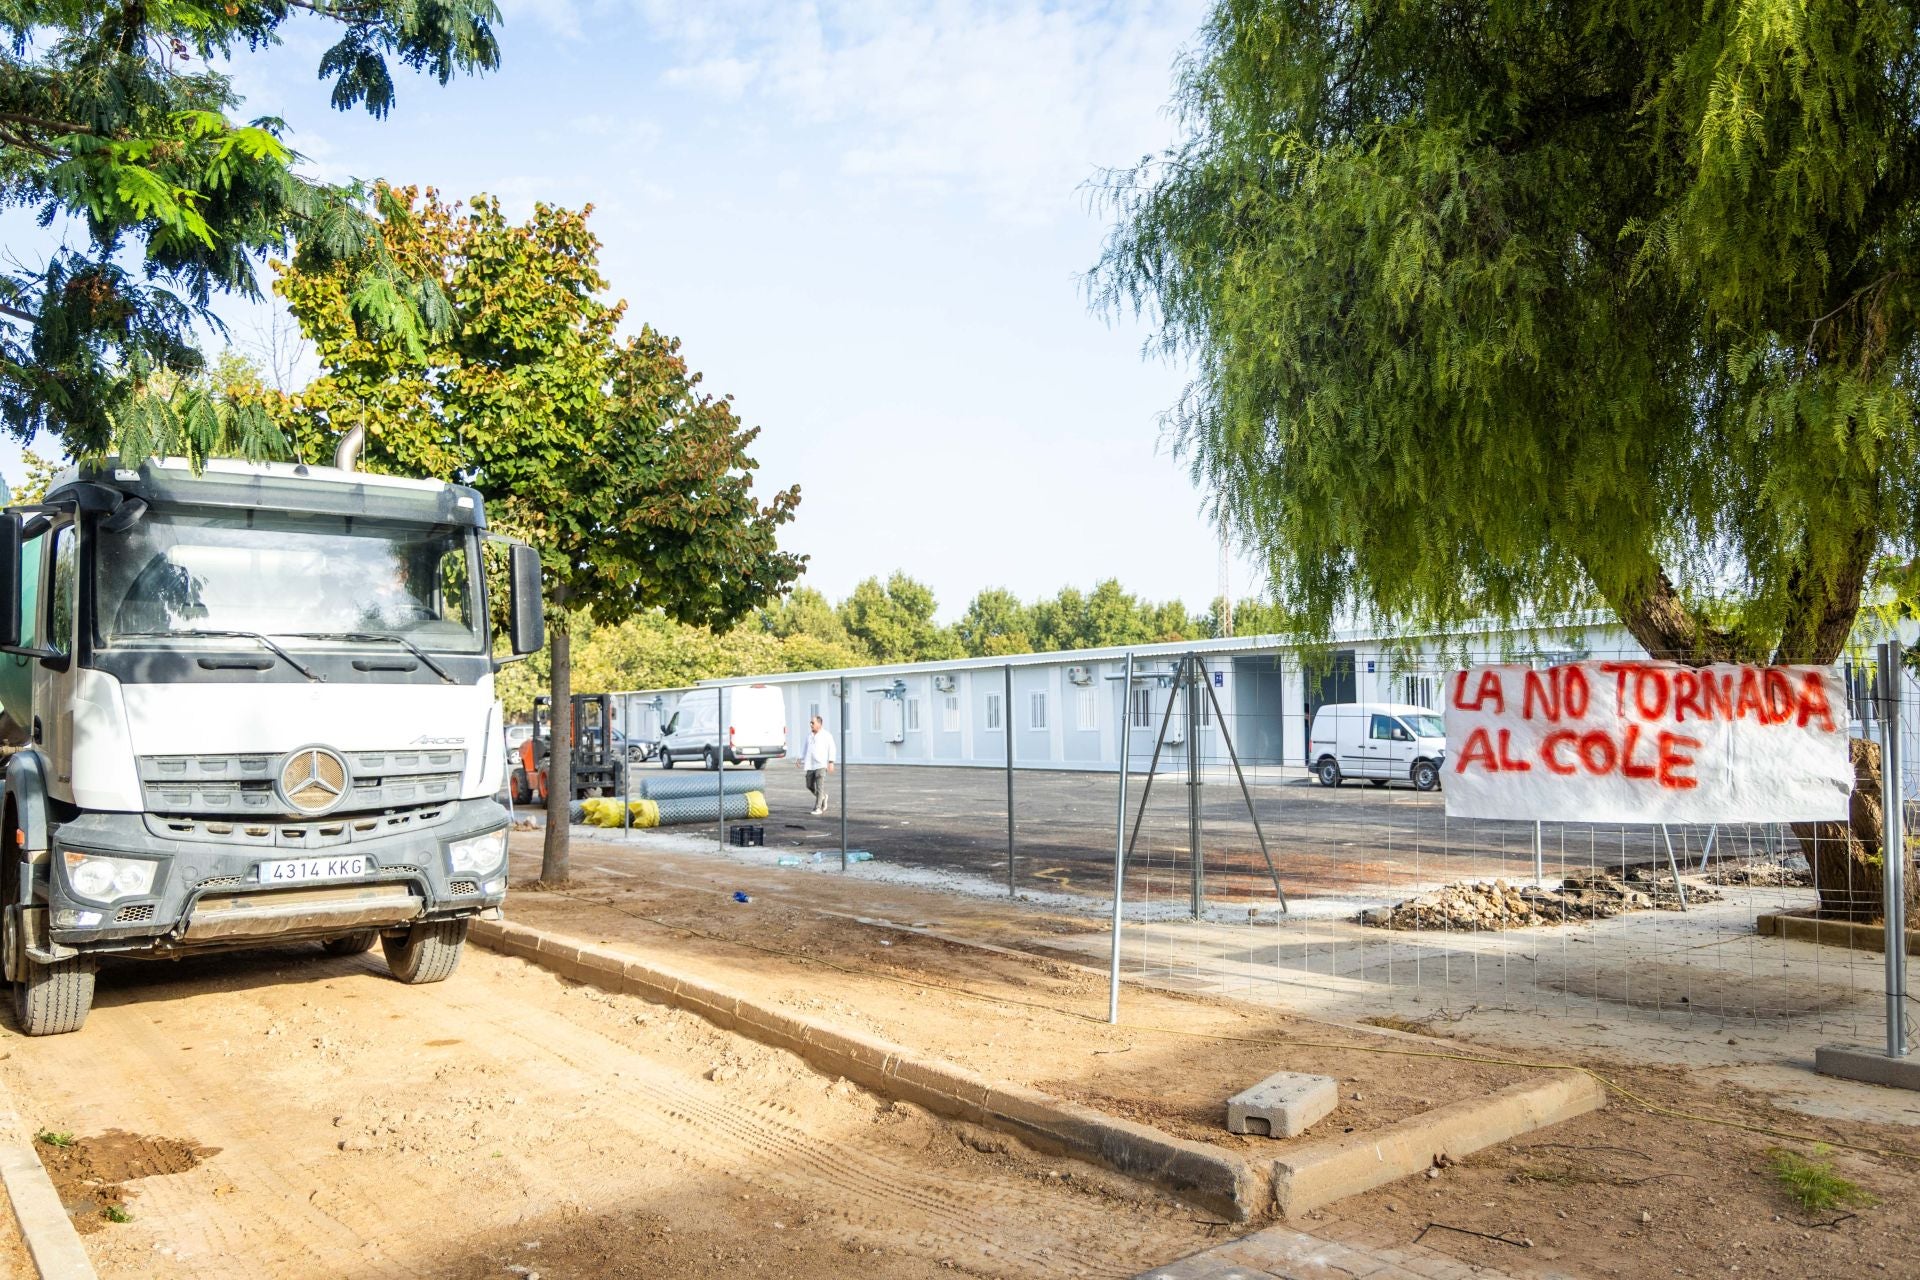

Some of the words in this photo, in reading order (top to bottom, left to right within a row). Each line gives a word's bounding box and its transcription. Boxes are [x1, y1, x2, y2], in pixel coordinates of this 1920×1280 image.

[1453, 670, 1506, 714] LA
[1522, 665, 1590, 722] NO
[1600, 662, 1837, 733] TORNADA
[1455, 727, 1532, 774] AL
[1540, 724, 1702, 789] COLE
[273, 862, 319, 879] 4314
[328, 859, 362, 876] KKG
